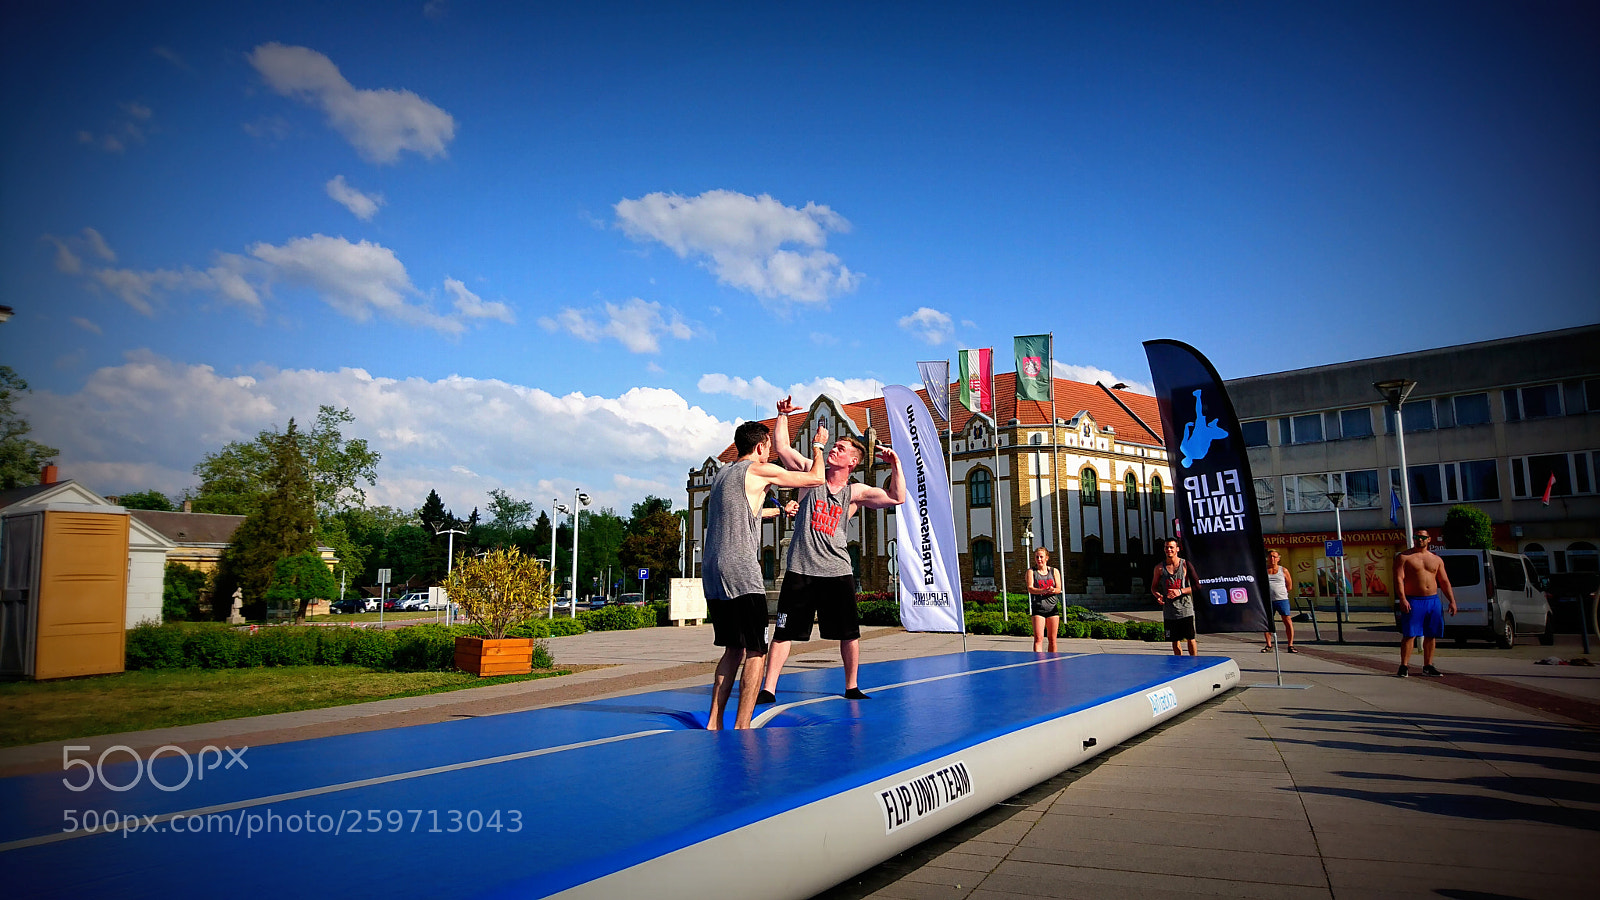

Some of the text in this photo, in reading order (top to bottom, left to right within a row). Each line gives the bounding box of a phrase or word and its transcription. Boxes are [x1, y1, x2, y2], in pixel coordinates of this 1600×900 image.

[815, 499, 843, 517] FLIP
[812, 511, 838, 526] UNIT
[640, 569, 647, 577] P
[881, 762, 971, 830] FLIP UNIT TEAM
